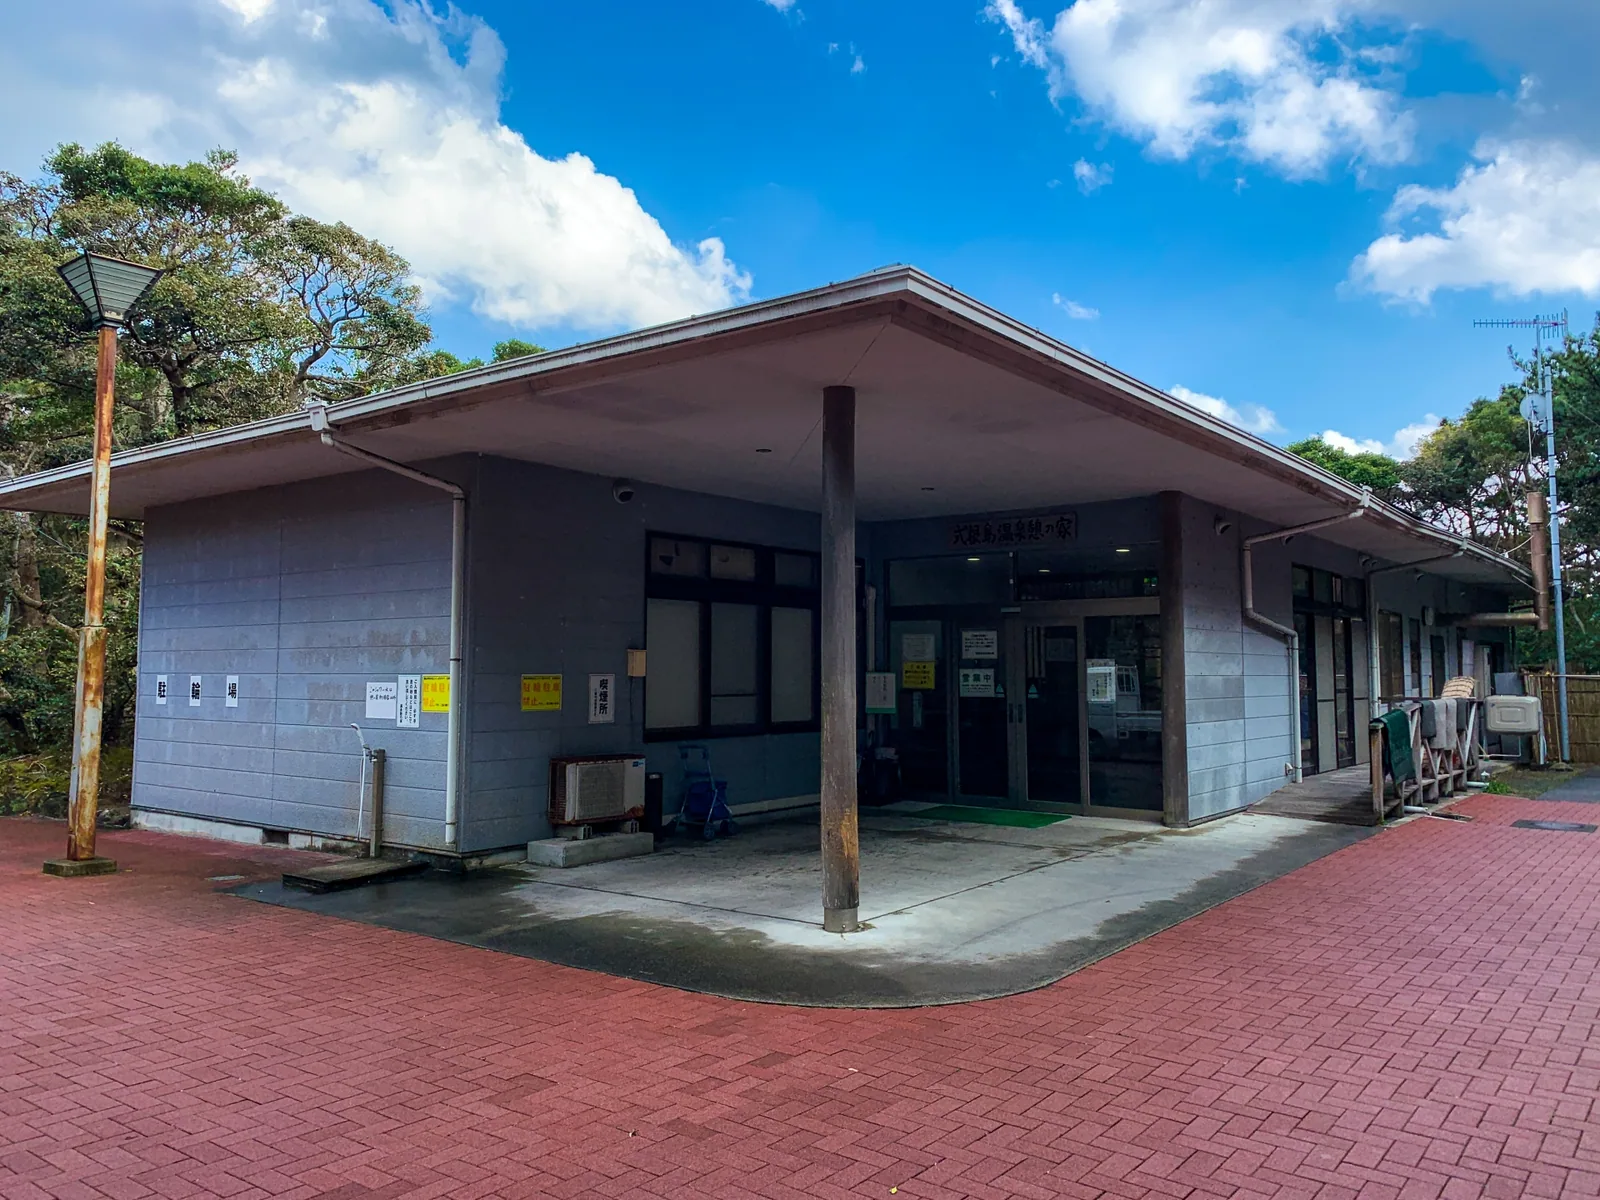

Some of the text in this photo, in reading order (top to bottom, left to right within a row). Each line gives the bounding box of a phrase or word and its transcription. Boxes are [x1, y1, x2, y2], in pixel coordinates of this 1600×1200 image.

[952, 516, 1073, 545] 式根島温泉憩の家
[599, 678, 609, 715] 喫煙所
